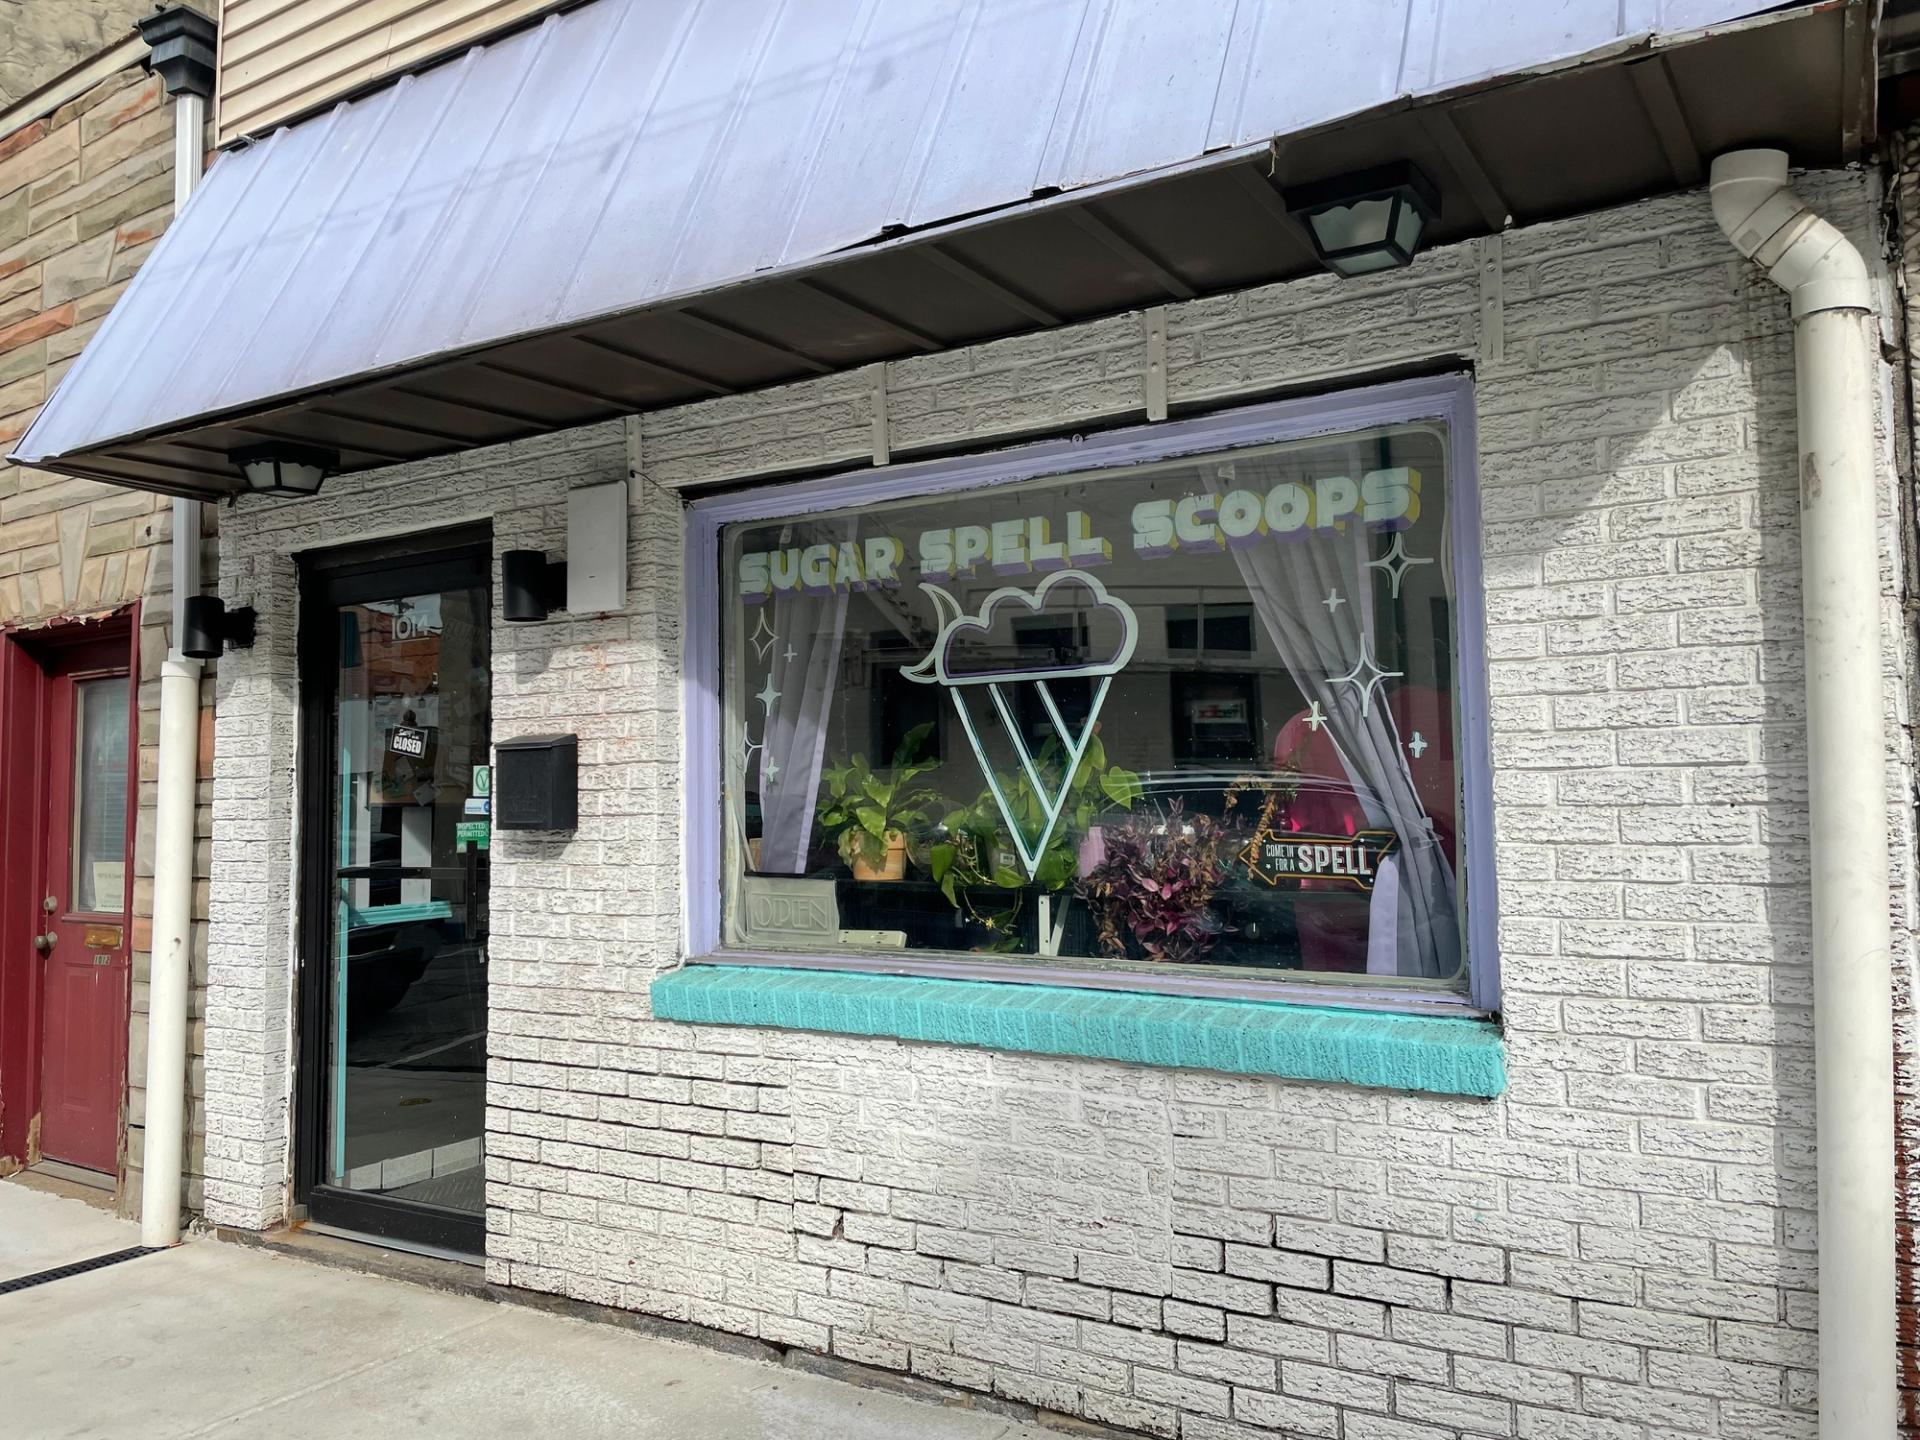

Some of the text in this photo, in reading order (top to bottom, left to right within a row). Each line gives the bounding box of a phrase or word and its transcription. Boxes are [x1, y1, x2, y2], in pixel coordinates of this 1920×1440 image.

[739, 467, 1422, 603] SUGAR SPELL SCOOPS
[392, 614, 429, 640] 1014
[393, 736, 422, 754] CLOSED
[1266, 844, 1295, 857] COME IN
[1297, 844, 1373, 875] SPELL
[1275, 858, 1295, 871] FOR A
[755, 897, 828, 929] OPEN
